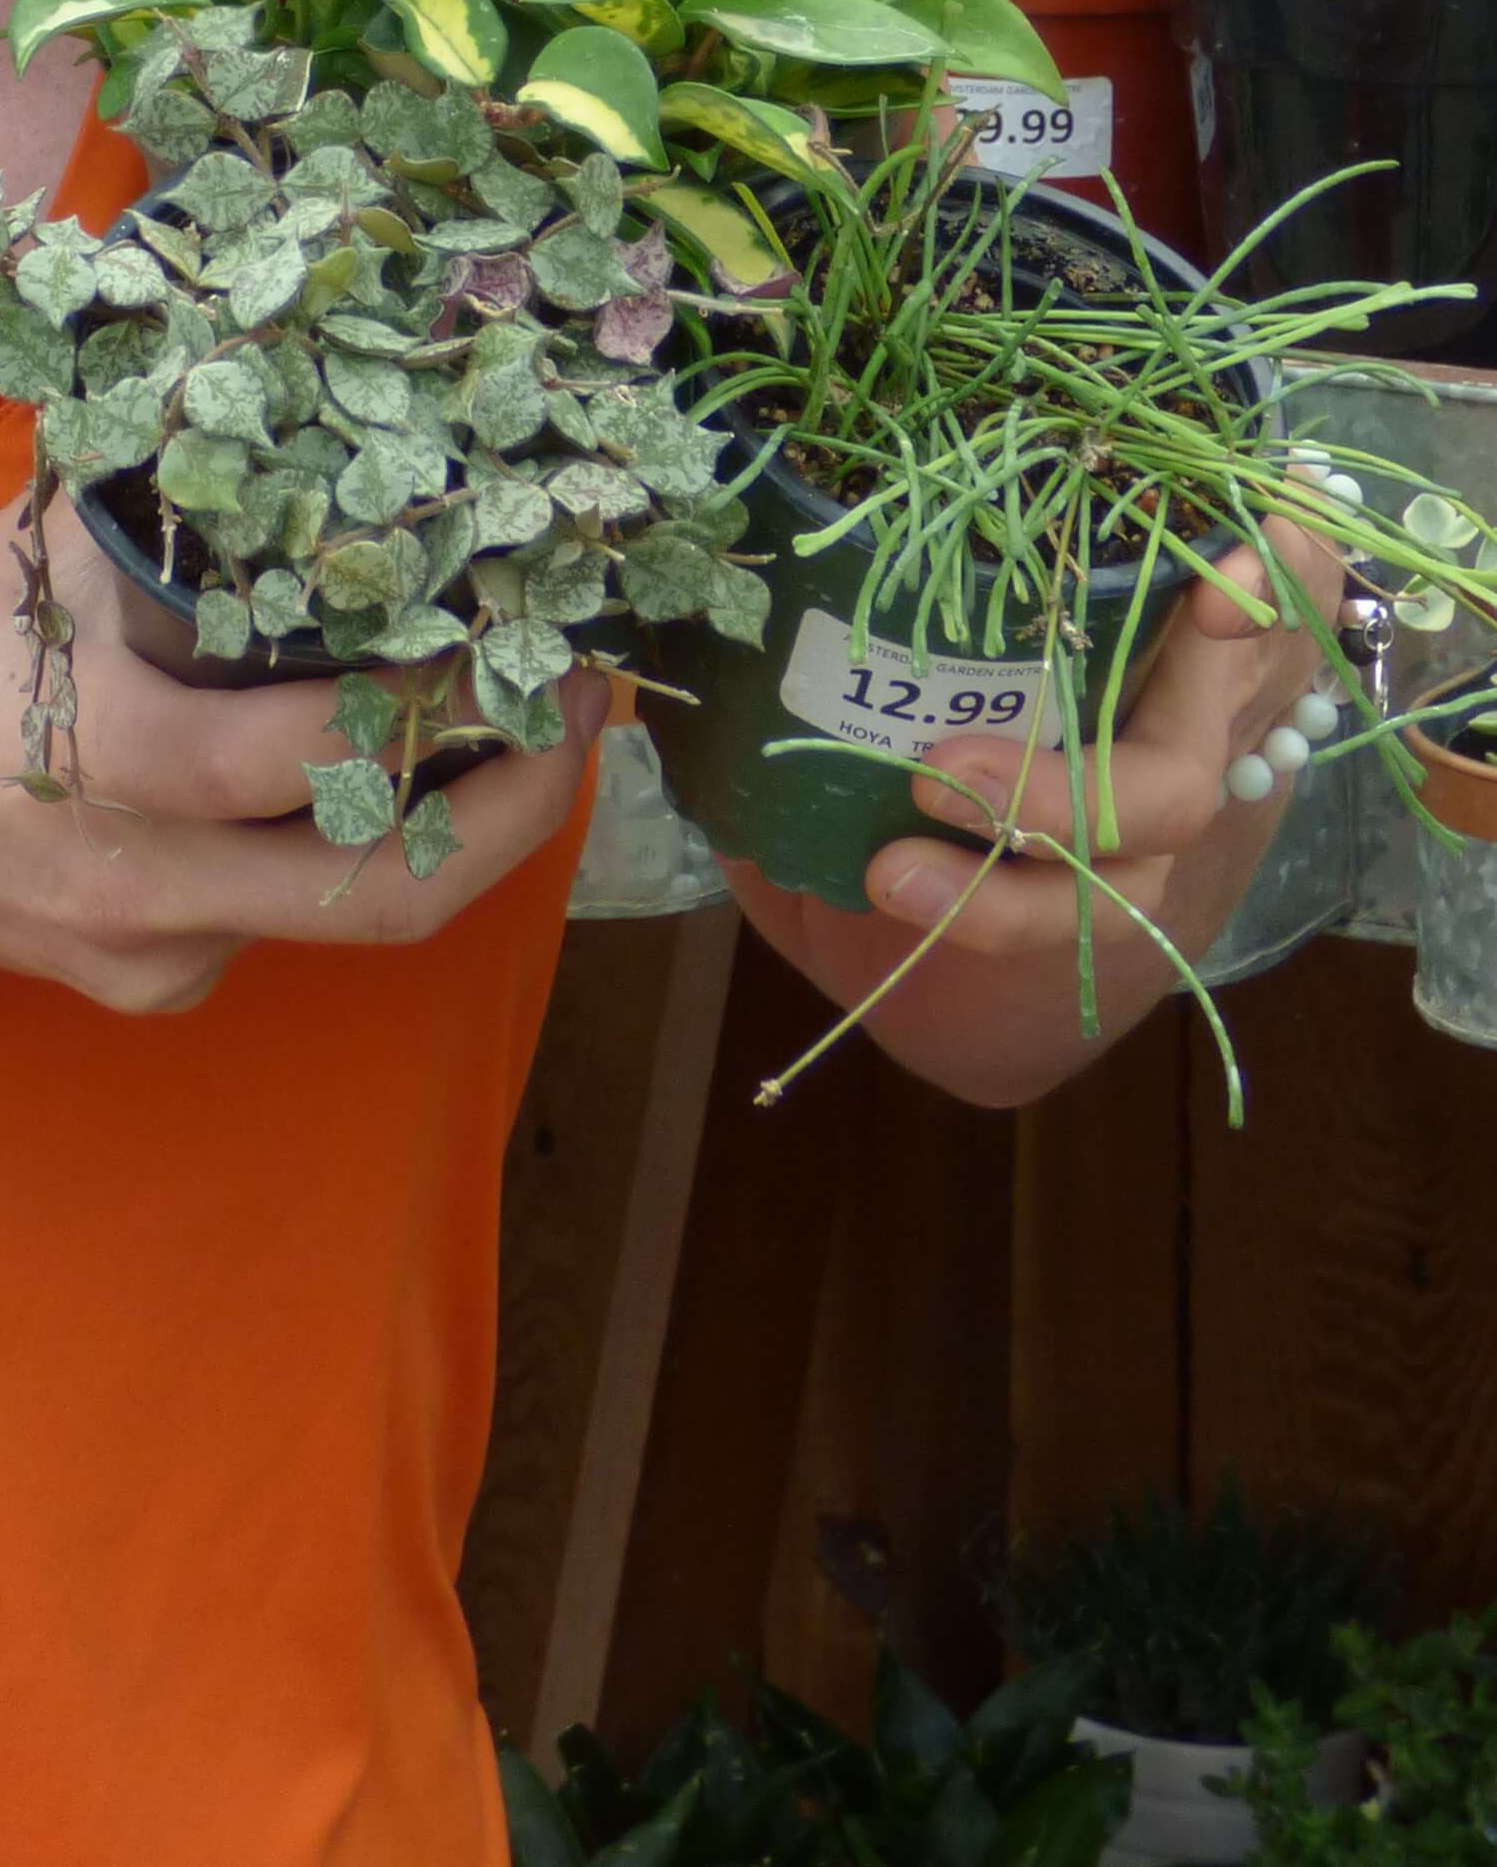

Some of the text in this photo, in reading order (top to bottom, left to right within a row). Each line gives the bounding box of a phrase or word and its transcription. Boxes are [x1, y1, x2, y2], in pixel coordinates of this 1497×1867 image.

[957, 108, 1074, 144] 9.99
[935, 663, 994, 677] GARDEN
[998, 666, 1043, 678] CENTR
[842, 668, 1027, 725] 12.99
[839, 720, 935, 753] HOYA TR
